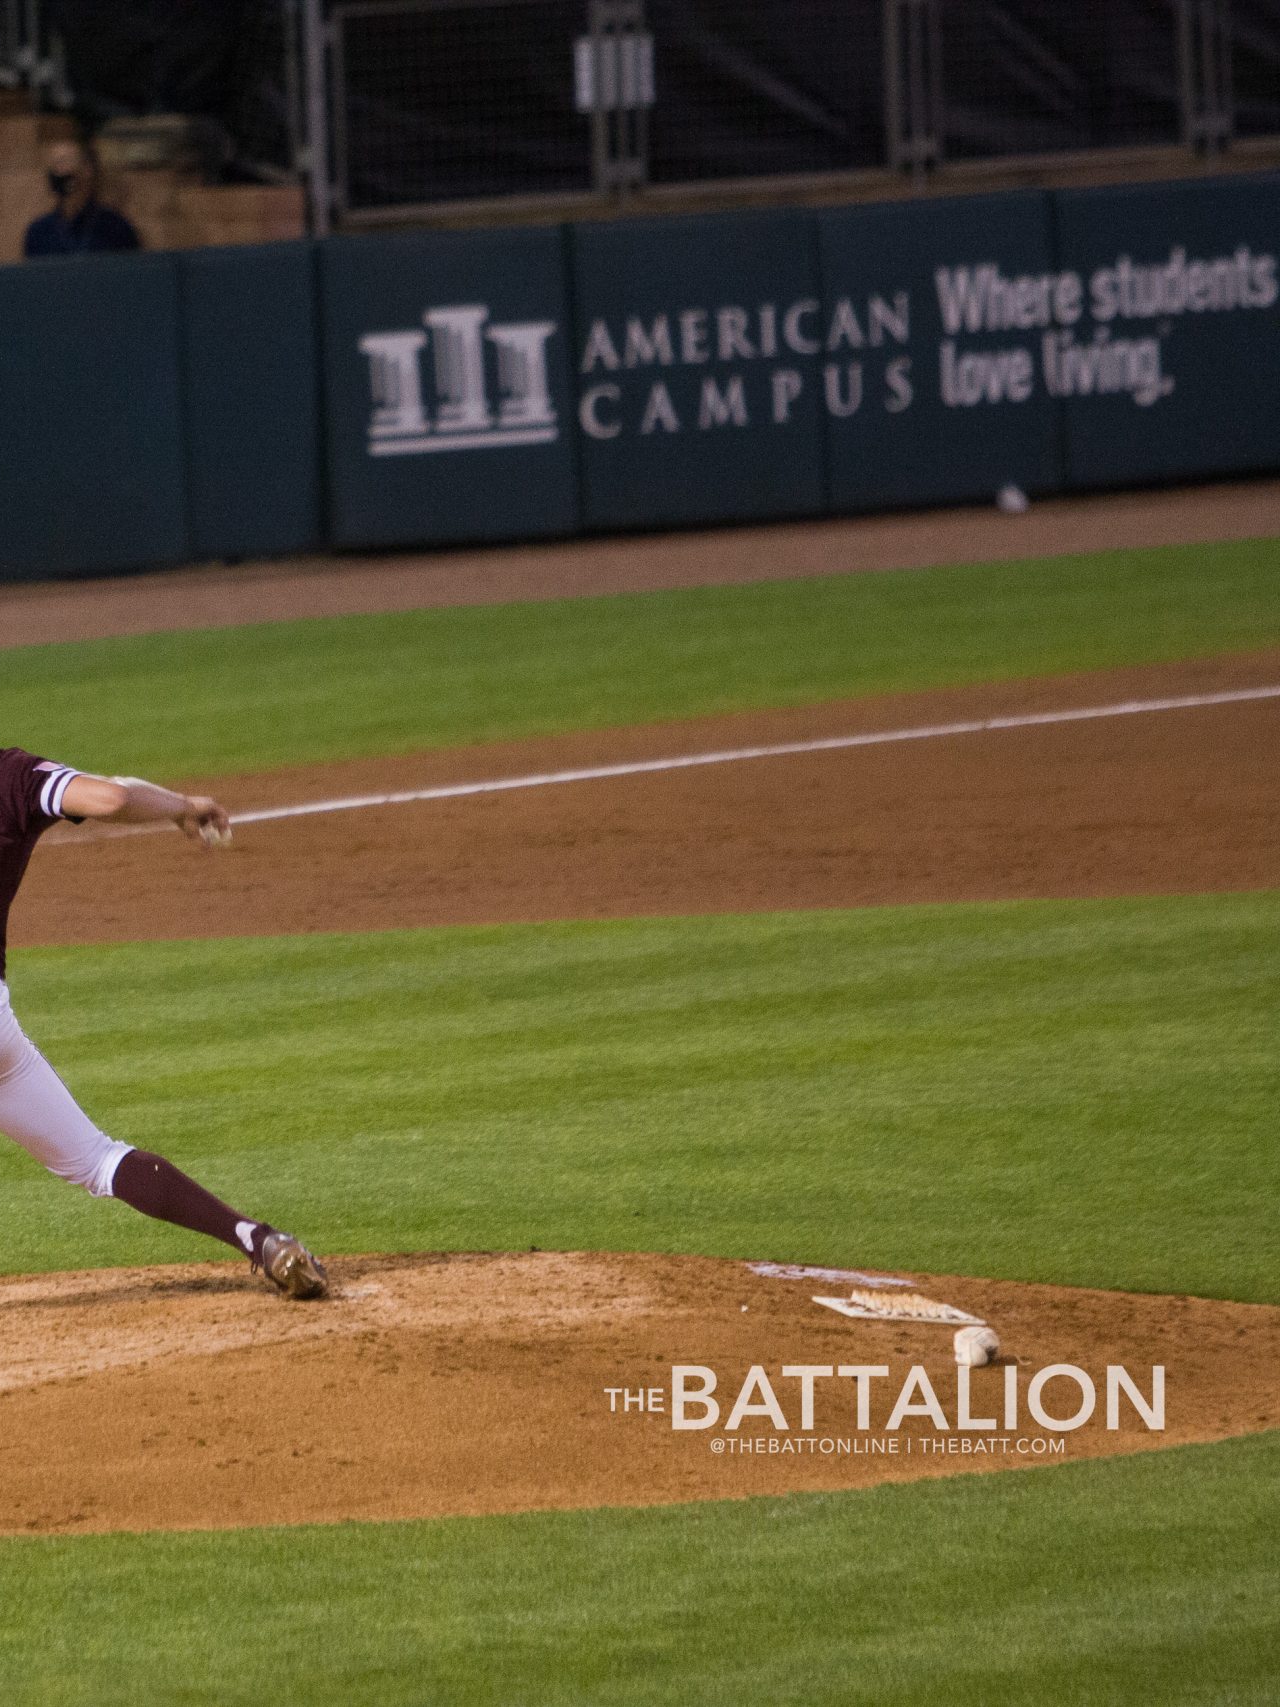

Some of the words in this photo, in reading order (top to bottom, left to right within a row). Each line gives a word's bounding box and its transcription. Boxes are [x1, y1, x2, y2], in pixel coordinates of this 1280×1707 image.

[935, 263, 1082, 333] Where
[1090, 246, 1277, 323] students
[581, 291, 910, 373] AMERICAN
[939, 338, 1033, 408] love
[579, 355, 914, 440] CAMPUS
